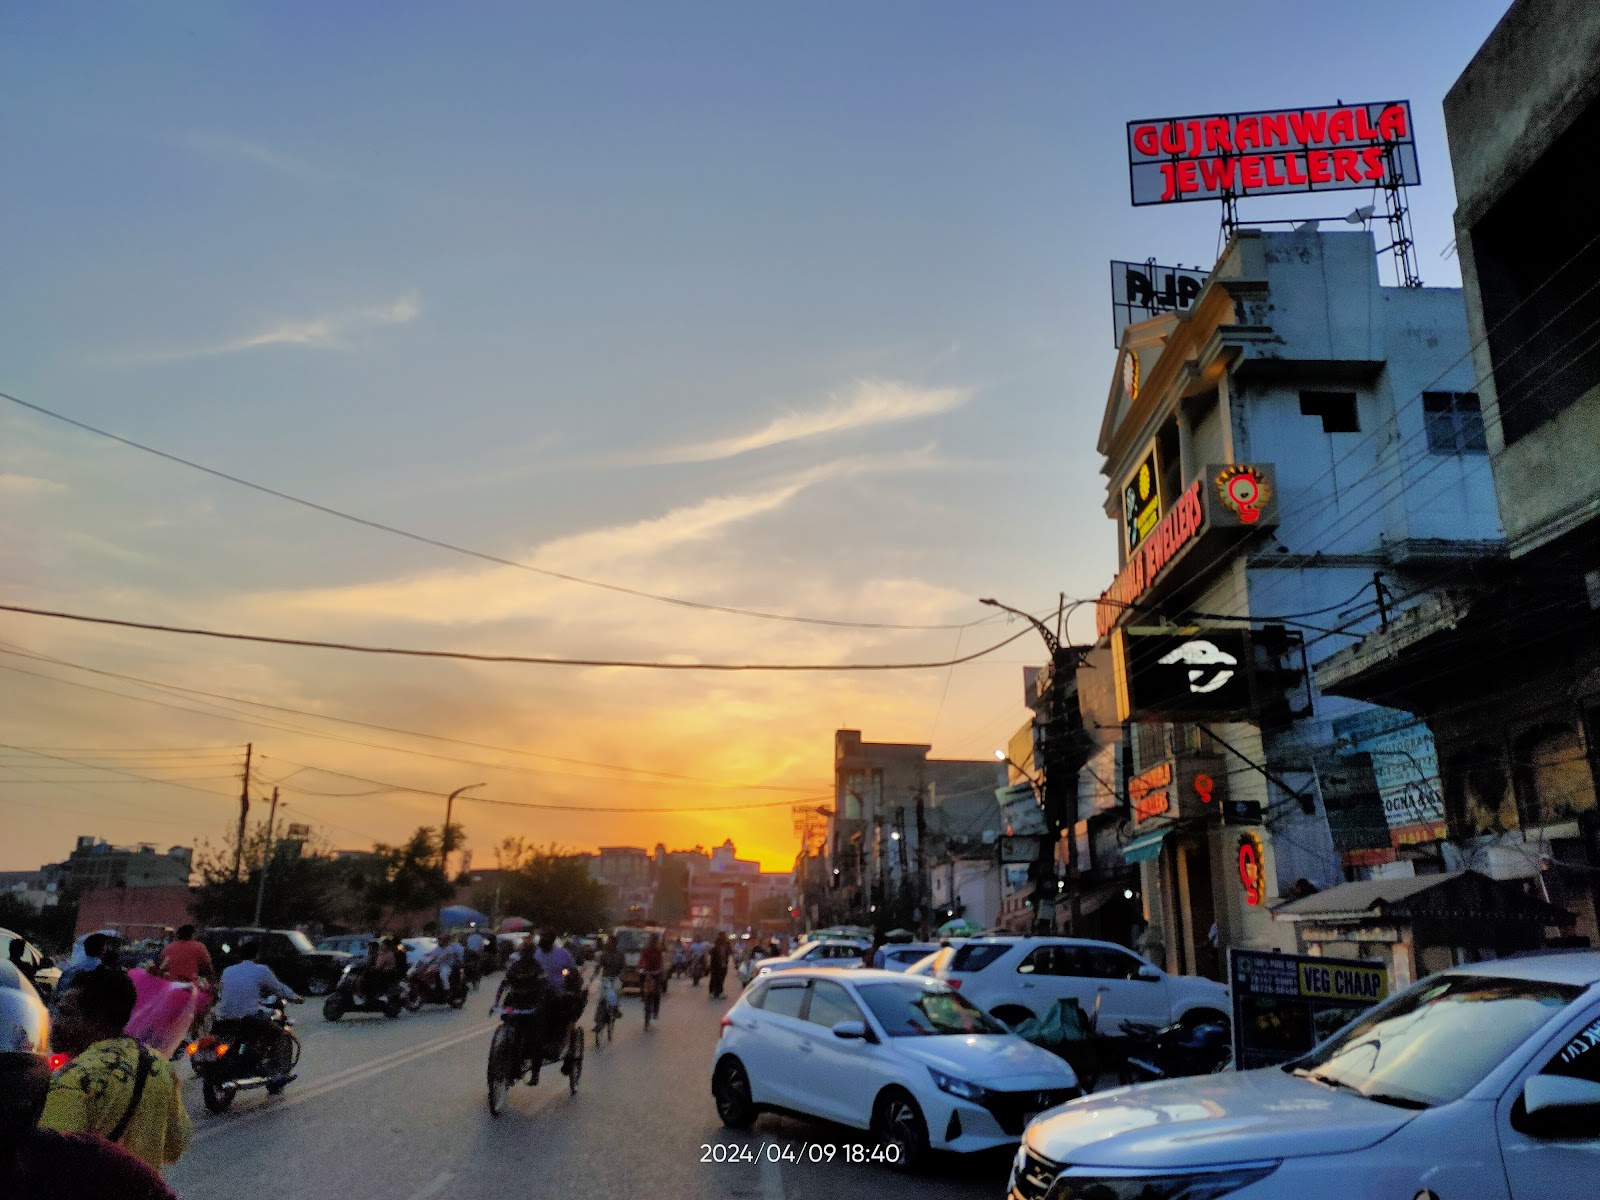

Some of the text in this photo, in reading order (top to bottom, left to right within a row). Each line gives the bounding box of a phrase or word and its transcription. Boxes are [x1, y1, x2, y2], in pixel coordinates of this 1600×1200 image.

[1134, 105, 1407, 158] GUJRANWALA
[1161, 148, 1385, 201] JEWELLERS
[1145, 480, 1202, 587] JEWELLERS
[1303, 966, 1330, 993] VEG
[1334, 969, 1381, 998] CHAAP
